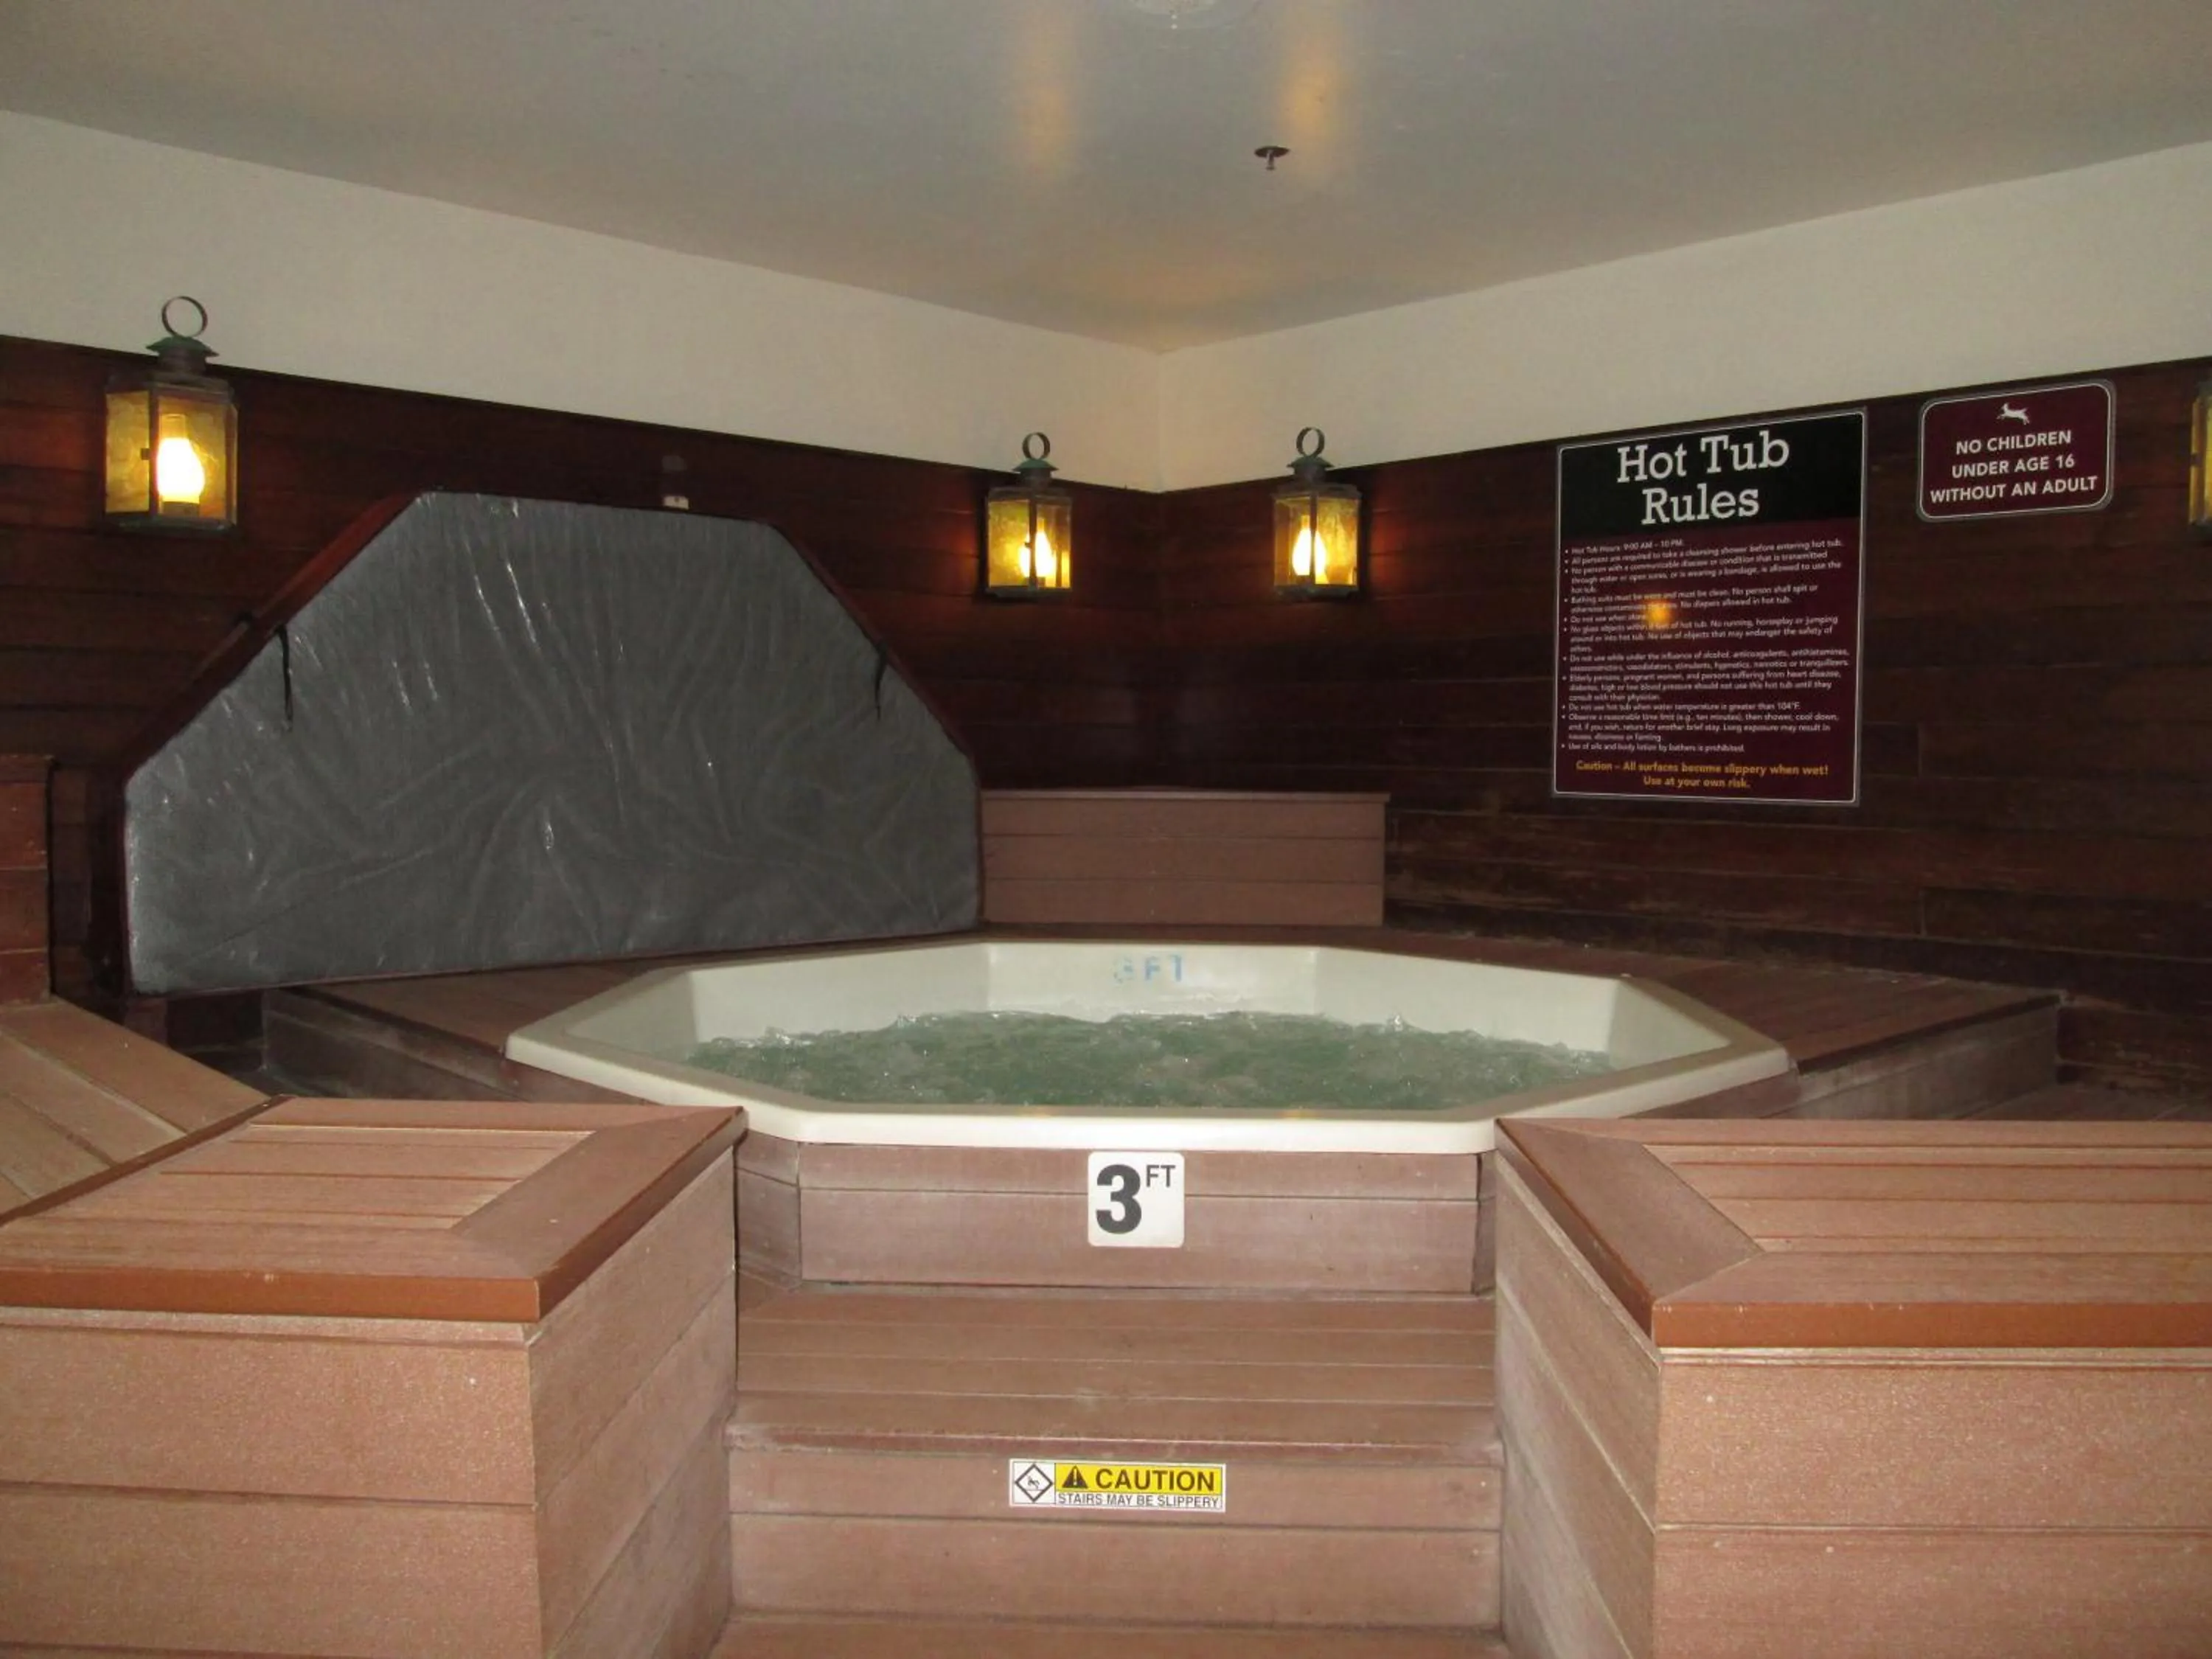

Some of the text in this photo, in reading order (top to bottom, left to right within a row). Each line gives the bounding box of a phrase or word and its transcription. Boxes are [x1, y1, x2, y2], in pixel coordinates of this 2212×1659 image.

[1956, 430, 2072, 455] NO CHILDREN
[1617, 430, 1790, 483] Hot Tub
[1952, 453, 2076, 479] UNDER AGE 16
[1930, 476, 2098, 503] WITHOUT AN ADULT
[1641, 483, 1759, 525] Rules
[1621, 552, 1650, 563] required
[1750, 543, 1774, 552] before
[1776, 540, 1809, 553] entering
[1812, 540, 1825, 548] hot
[1639, 541, 1652, 549] AM
[1583, 567, 1606, 576] person
[1719, 555, 1754, 565] condition
[1756, 554, 1772, 563] that
[1781, 550, 1828, 560] transmitted
[1571, 575, 1598, 586] through
[1629, 574, 1646, 583] open
[1770, 563, 1799, 572] allowed
[1801, 562, 1809, 570] to
[1827, 560, 1841, 568] the
[1697, 589, 1707, 597] be
[1745, 588, 1771, 597] person
[1773, 585, 1790, 593] shall
[1792, 584, 1807, 595] spit
[1722, 597, 1750, 606] allowed
[1680, 620, 1692, 628] hot
[1710, 619, 1721, 627] No
[1756, 616, 1792, 628] horseplay
[1805, 614, 1838, 626] jumping
[1711, 630, 1725, 638] that
[1728, 631, 1742, 640] may
[1745, 627, 1781, 639] endanger
[1784, 627, 1796, 635] the
[1798, 626, 1821, 637] safety
[1823, 625, 1833, 633] of
[1701, 673, 1729, 682] persons
[1731, 671, 1764, 681] suffering
[1766, 670, 1784, 678] from
[1787, 669, 1806, 678] heart
[1814, 680, 1832, 691] they
[1728, 702, 1755, 712] greater
[1723, 723, 1742, 733] Long
[1744, 725, 1779, 734] exposure
[1780, 725, 1796, 734] may
[1576, 760, 1613, 771] Caution
[1622, 761, 1636, 771] All
[1638, 762, 1679, 772] surfaces
[1681, 762, 1720, 773] become
[1724, 763, 1765, 776] slippery
[1770, 764, 1799, 775] when
[1802, 764, 1829, 776] wet!
[1644, 775, 1750, 789] Use at your own risk.
[1096, 1164, 1176, 1234] 3 FT
[1096, 1468, 1214, 1491] CAUTION
[1058, 1494, 1220, 1509] STAIRS MAY BE SLIPPERY
